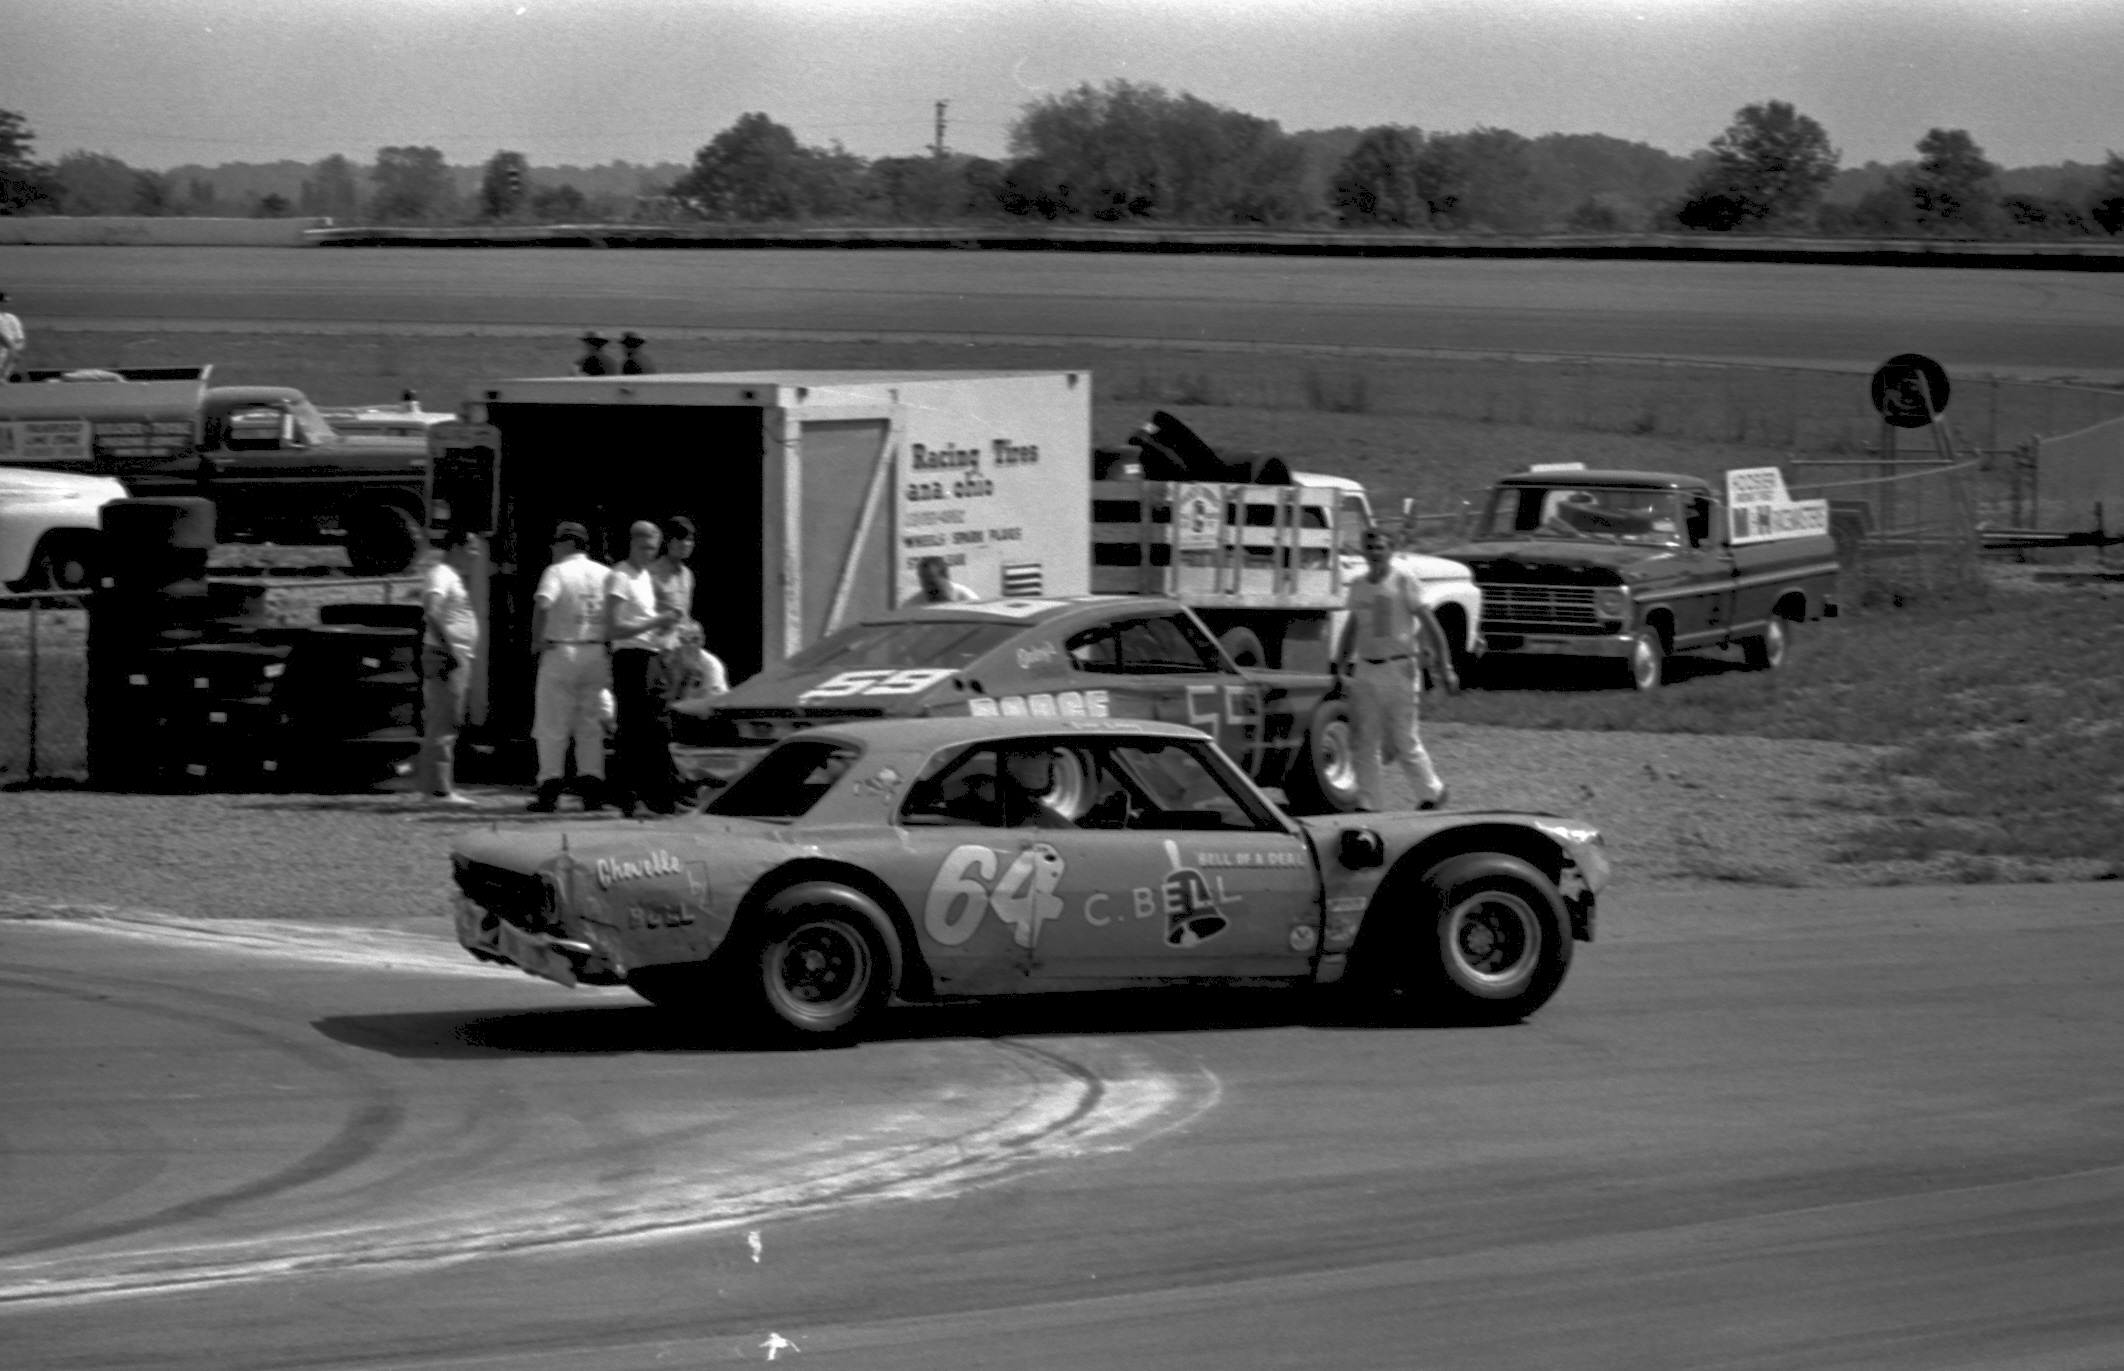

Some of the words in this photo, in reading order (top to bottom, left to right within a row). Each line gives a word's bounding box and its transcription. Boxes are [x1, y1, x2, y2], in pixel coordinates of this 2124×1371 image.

[911, 442, 980, 475] Racing
[993, 438, 1039, 466] Tires
[924, 843, 1066, 949] 64
